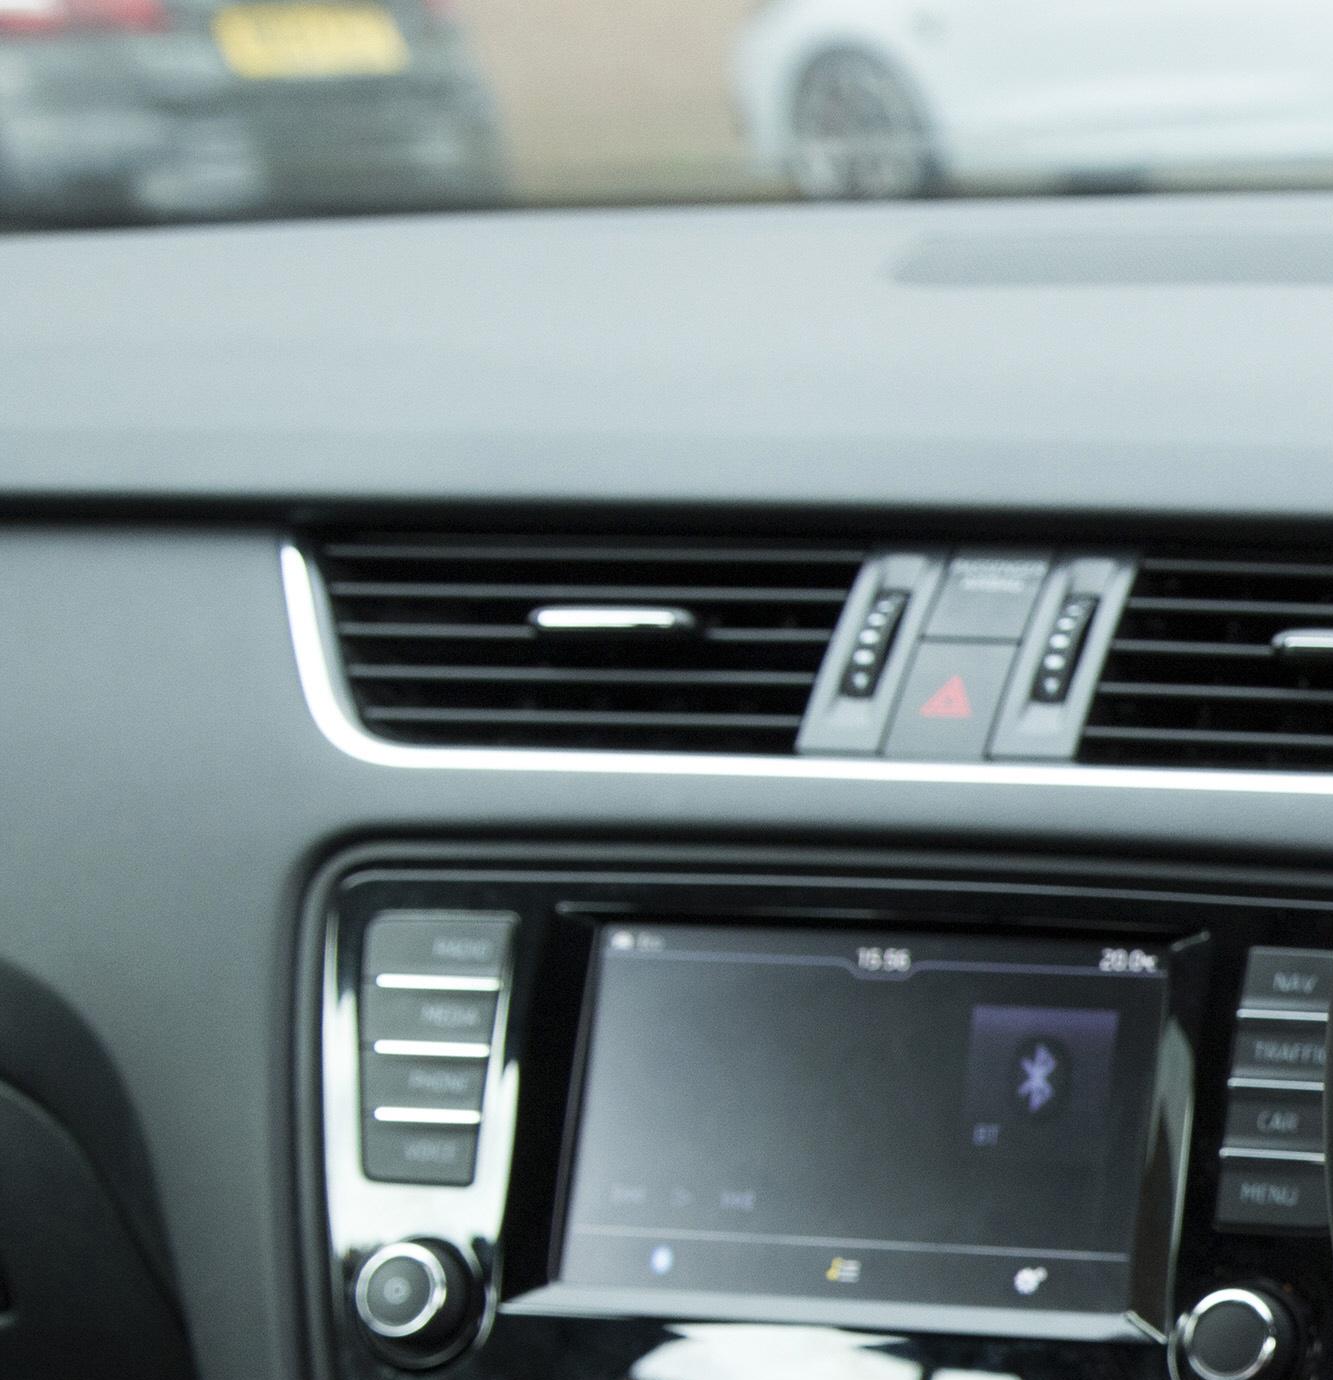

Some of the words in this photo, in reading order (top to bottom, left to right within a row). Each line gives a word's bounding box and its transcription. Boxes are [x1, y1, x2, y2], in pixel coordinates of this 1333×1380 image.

[1273, 971, 1319, 994] NAV
[1256, 1111, 1298, 1133] CAR
[1240, 1182, 1299, 1207] MENU
